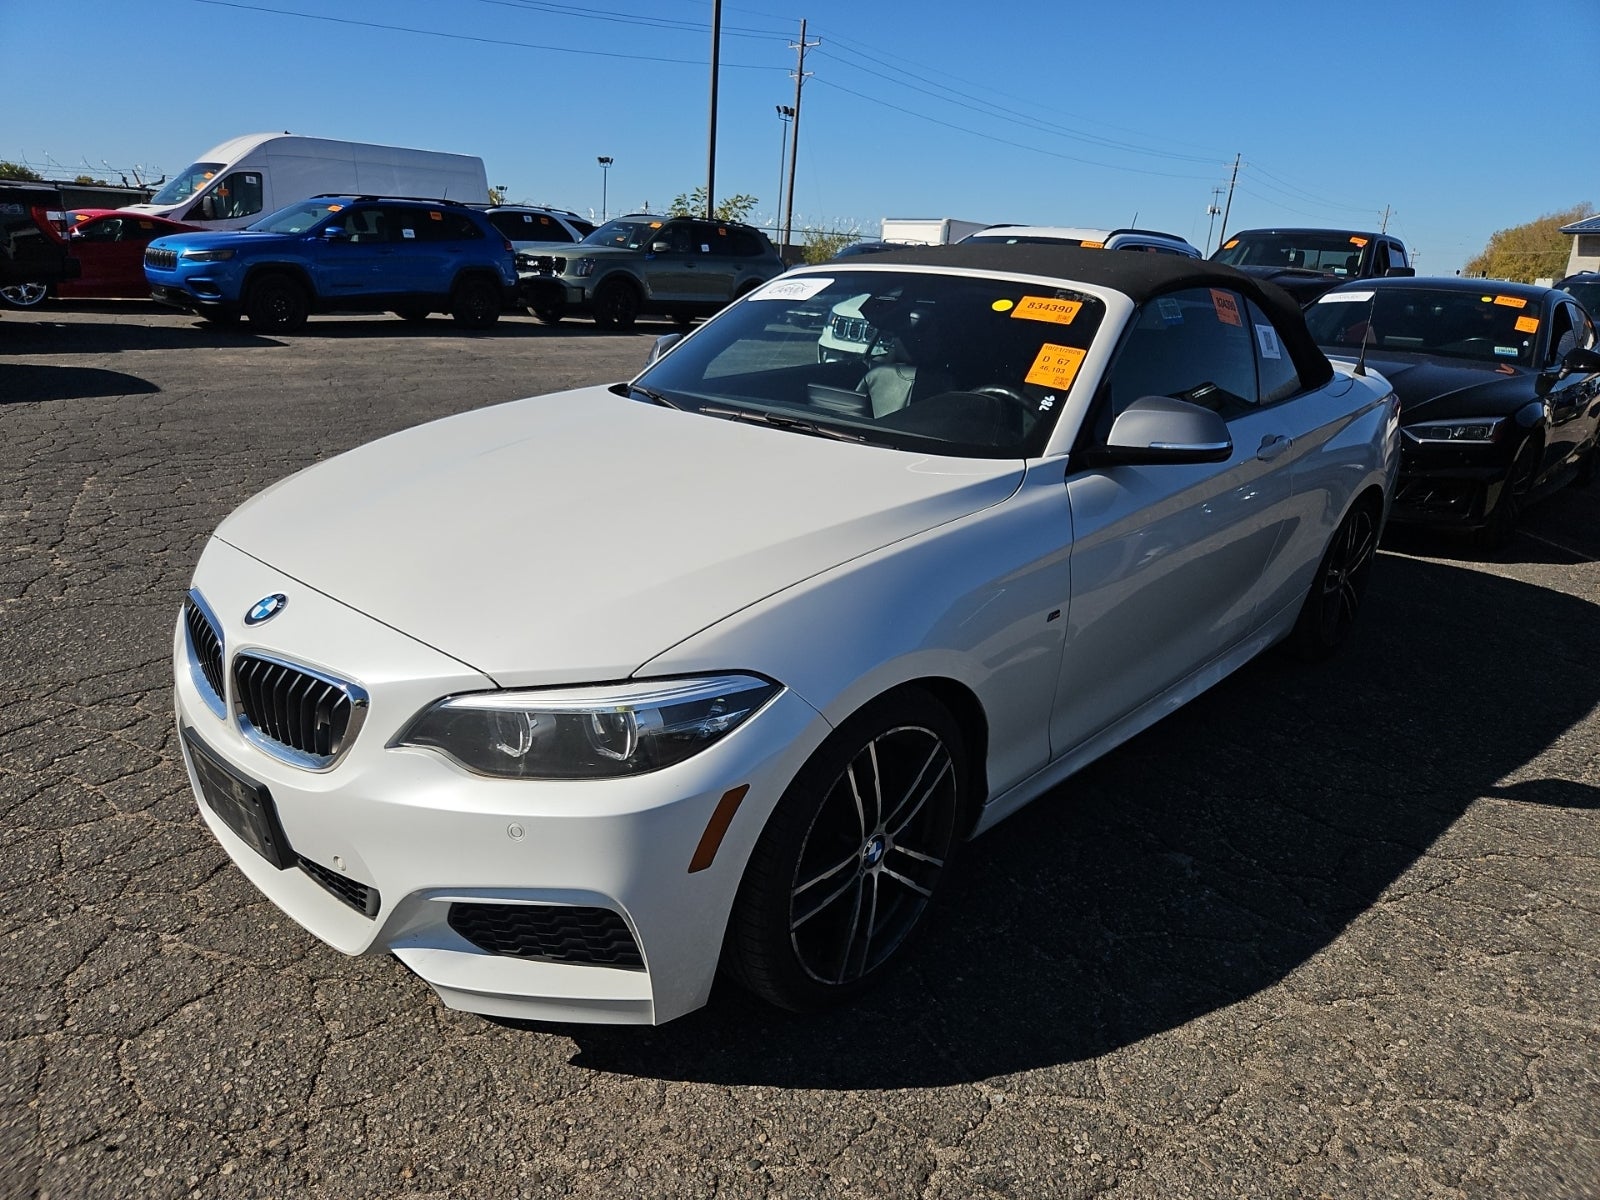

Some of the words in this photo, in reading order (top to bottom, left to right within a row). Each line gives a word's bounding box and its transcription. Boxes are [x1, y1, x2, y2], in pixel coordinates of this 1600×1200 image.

[1027, 302, 1073, 314] 834390
[1042, 355, 1050, 363] D
[1056, 358, 1070, 366] 67
[1038, 395, 1056, 411] 786
